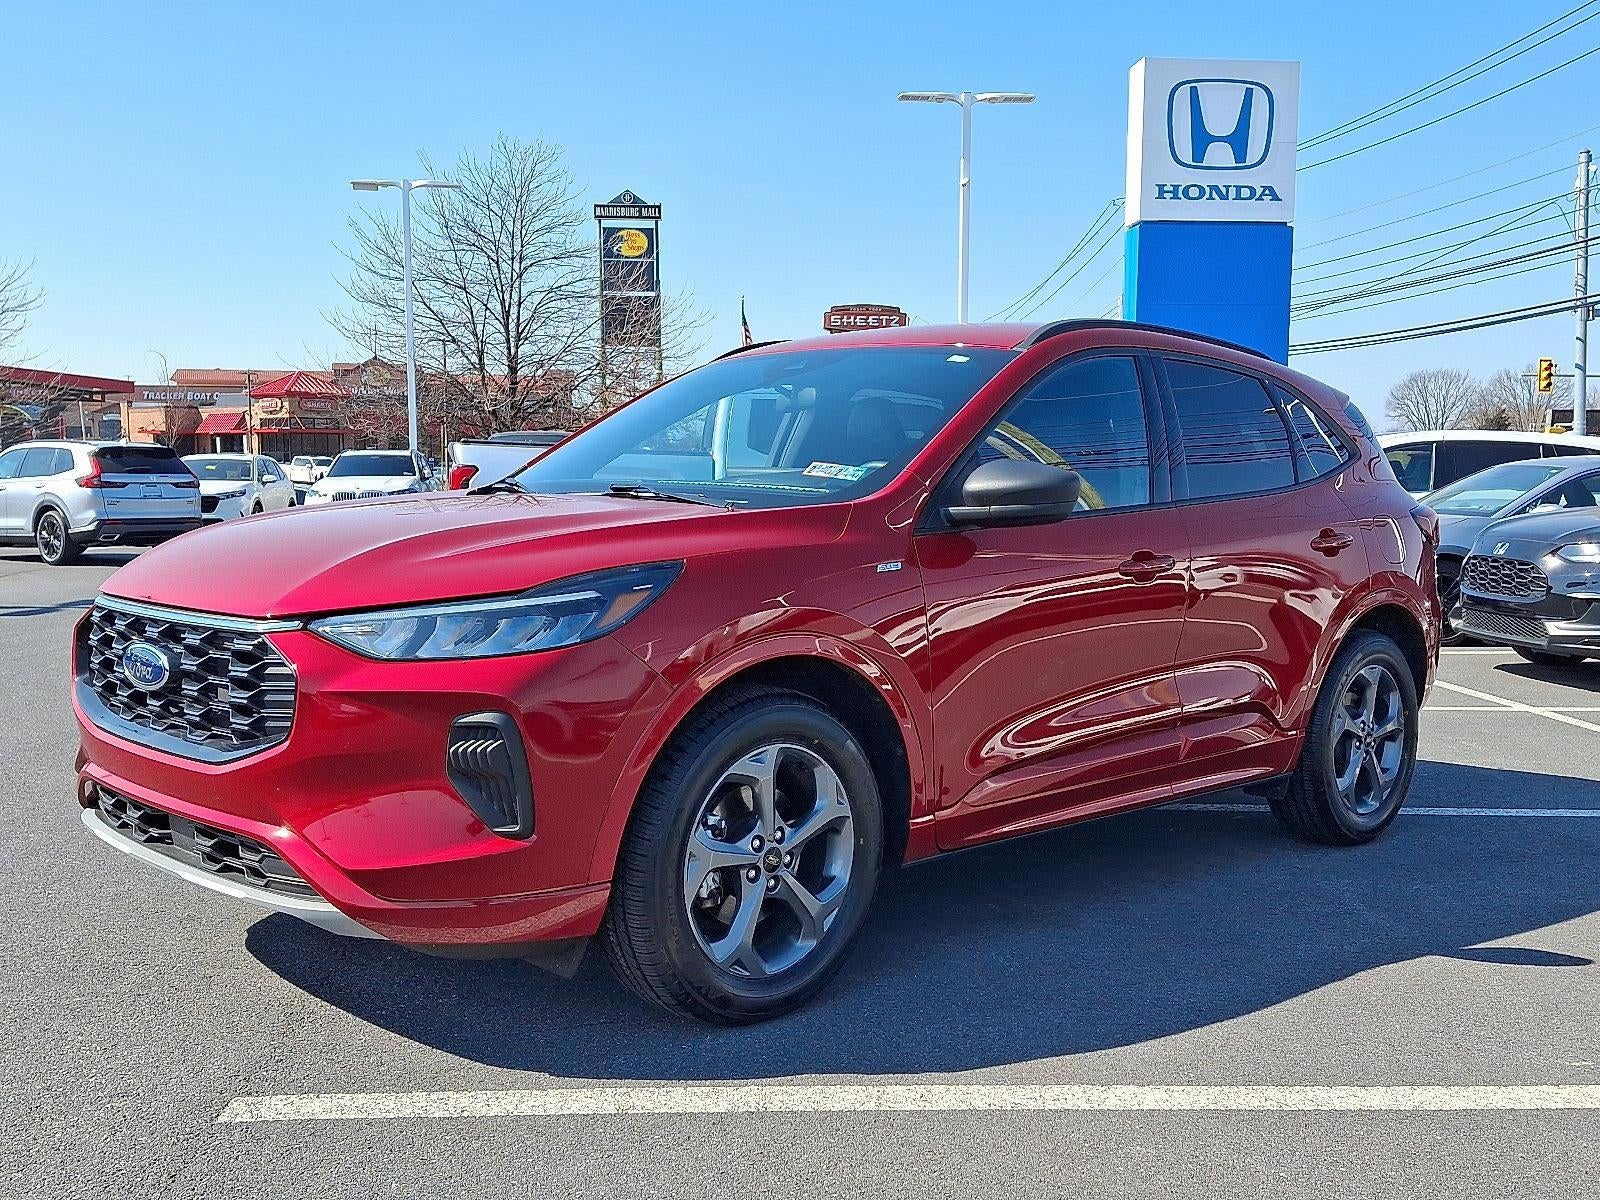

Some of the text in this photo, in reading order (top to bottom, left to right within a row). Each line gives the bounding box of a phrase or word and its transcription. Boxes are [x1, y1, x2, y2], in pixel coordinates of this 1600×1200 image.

[1154, 183, 1283, 202] HONDA
[595, 206, 660, 217] HARRISBURG MALL
[625, 230, 641, 239] Bass
[830, 315, 900, 327] SHEETZ
[142, 390, 185, 400] TRACKER
[187, 391, 211, 401] BOAT
